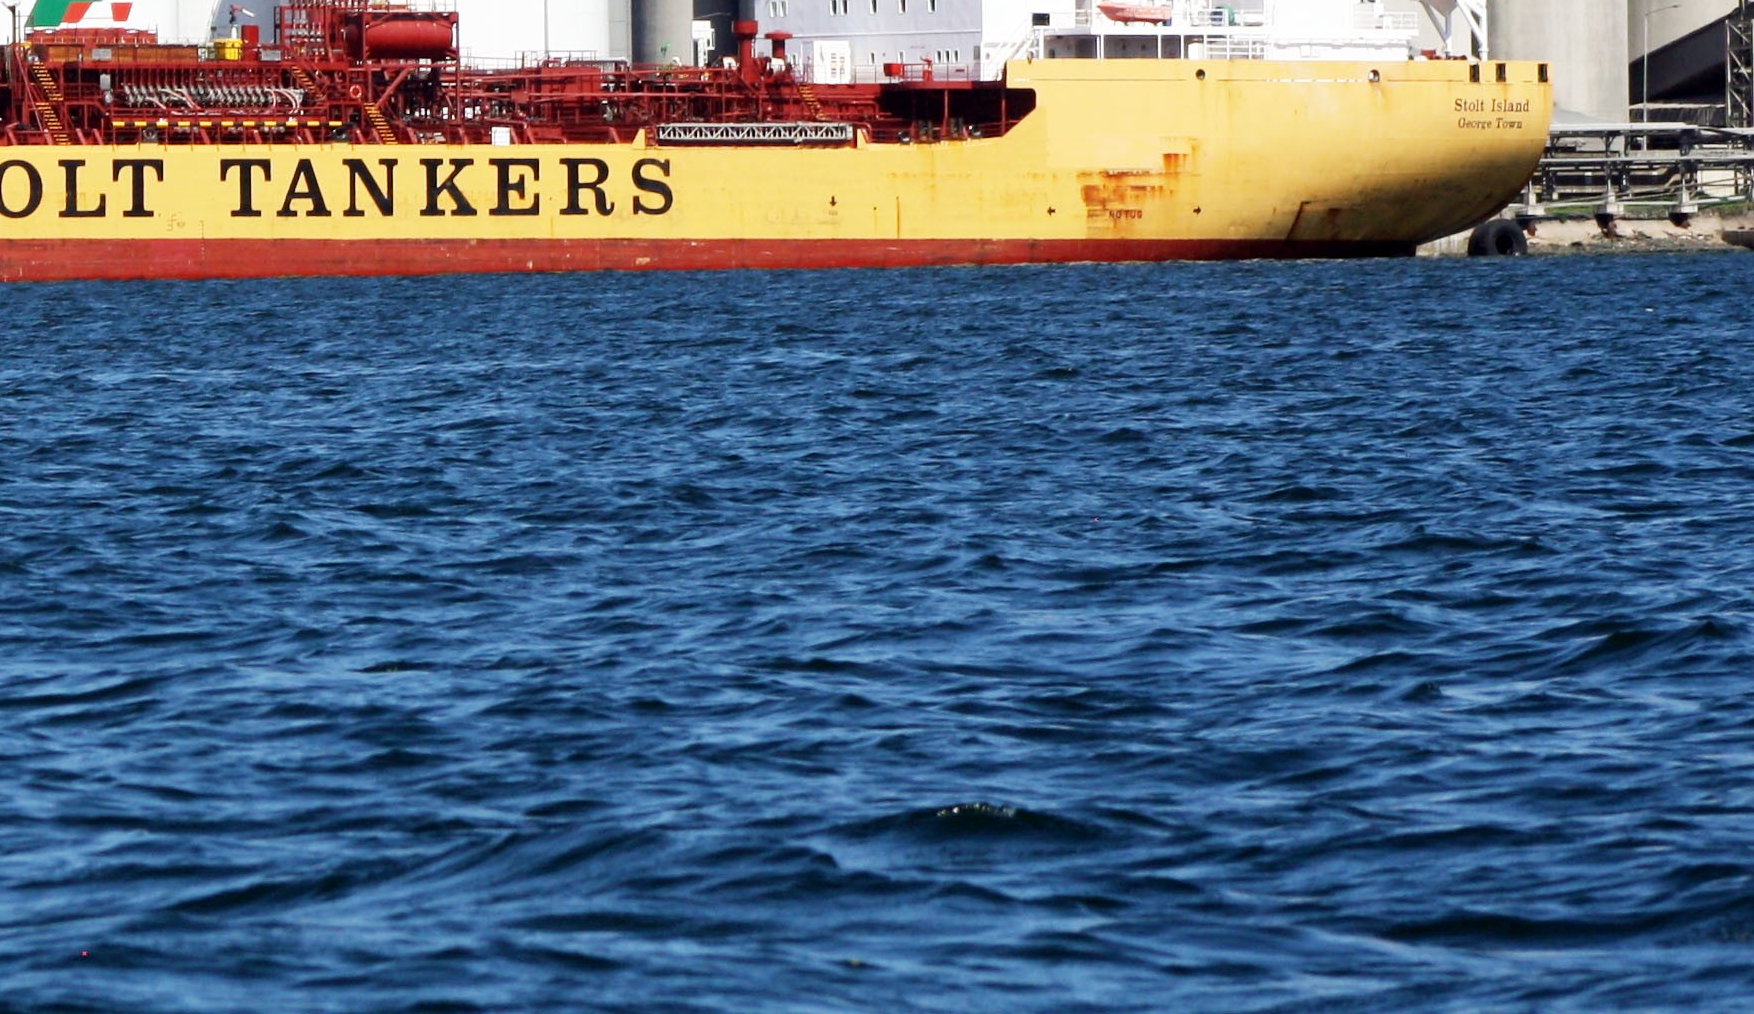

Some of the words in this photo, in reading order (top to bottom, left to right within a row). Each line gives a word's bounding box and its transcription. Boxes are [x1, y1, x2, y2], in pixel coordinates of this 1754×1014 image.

[1454, 98, 1484, 113] Stolt
[1491, 98, 1530, 113] Island
[1457, 116, 1492, 130] George
[1495, 117, 1523, 129] Town
[220, 157, 673, 217] TANKERS
